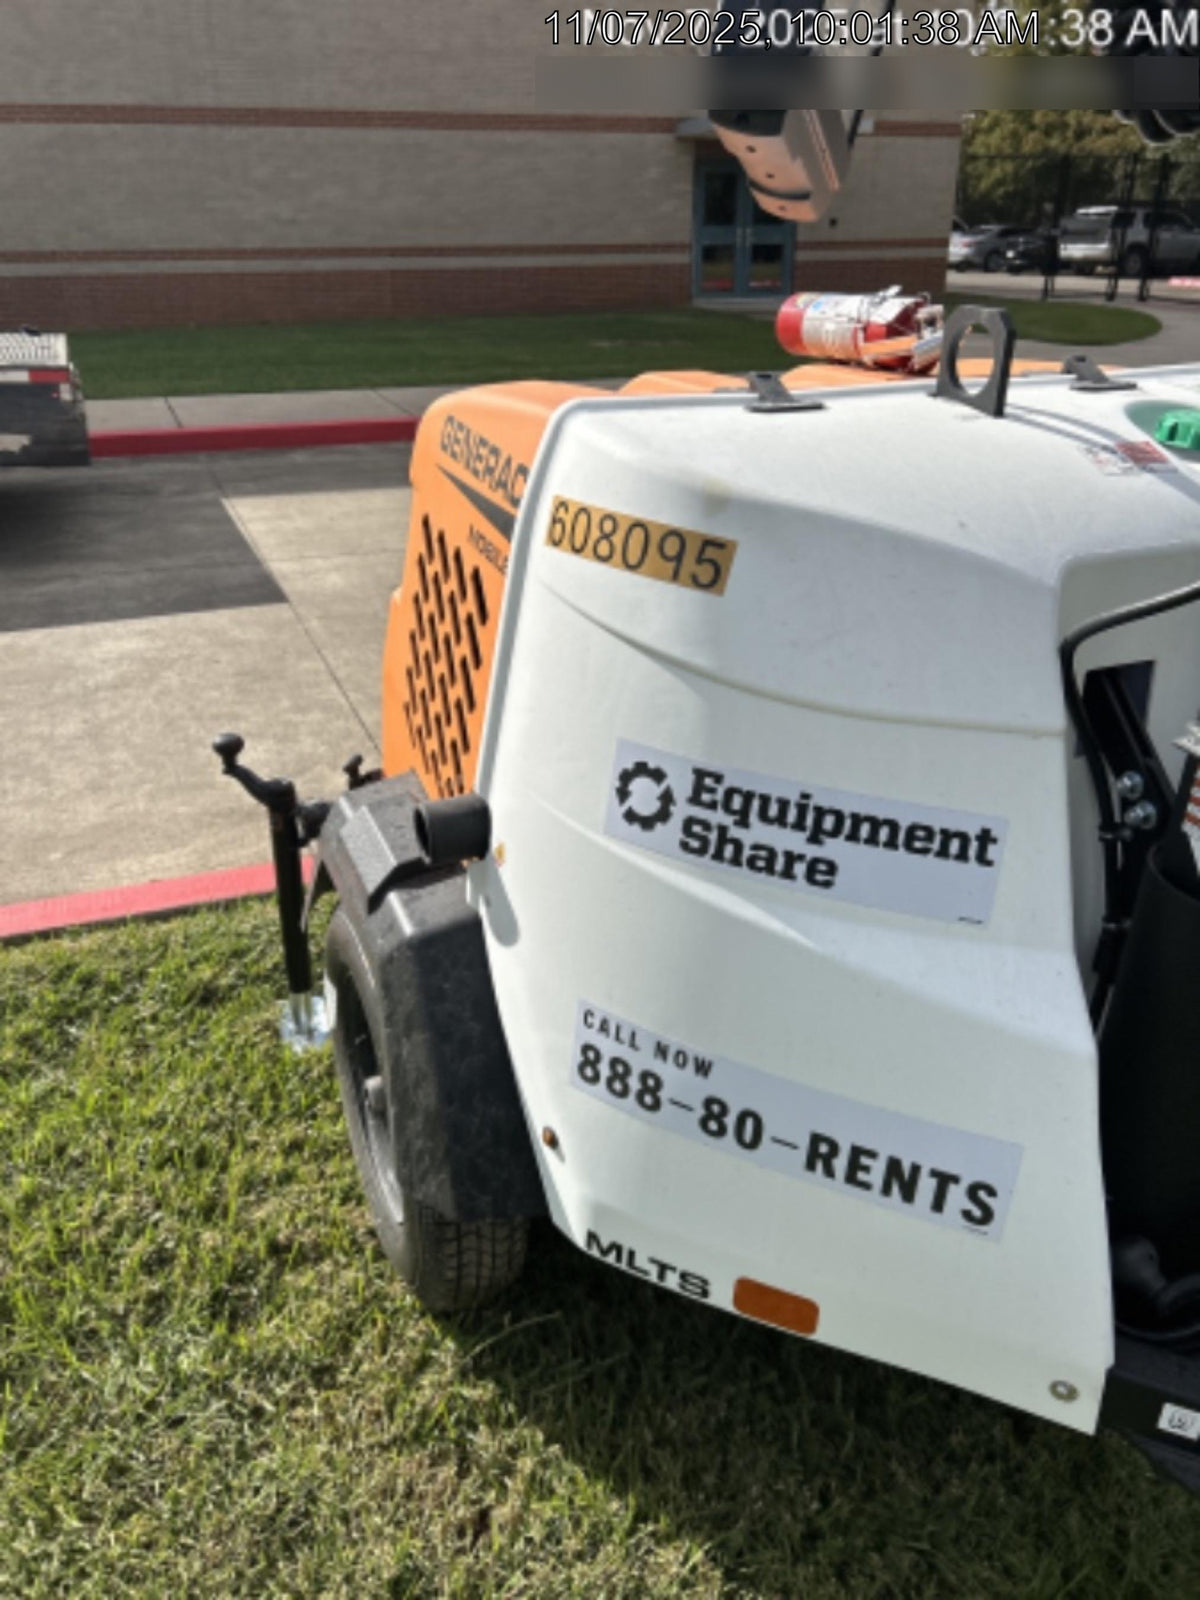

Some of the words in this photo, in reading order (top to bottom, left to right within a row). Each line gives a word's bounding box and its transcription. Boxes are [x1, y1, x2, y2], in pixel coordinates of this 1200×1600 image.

[441, 414, 530, 508] GENERAC
[550, 500, 727, 590] 608095
[679, 815, 838, 889] Share
[686, 766, 998, 867] Equipment
[583, 1009, 641, 1052] CALL
[654, 1040, 714, 1080] NOW
[576, 1042, 999, 1227] 888-80-RENTS
[585, 1228, 711, 1301] MLTS
